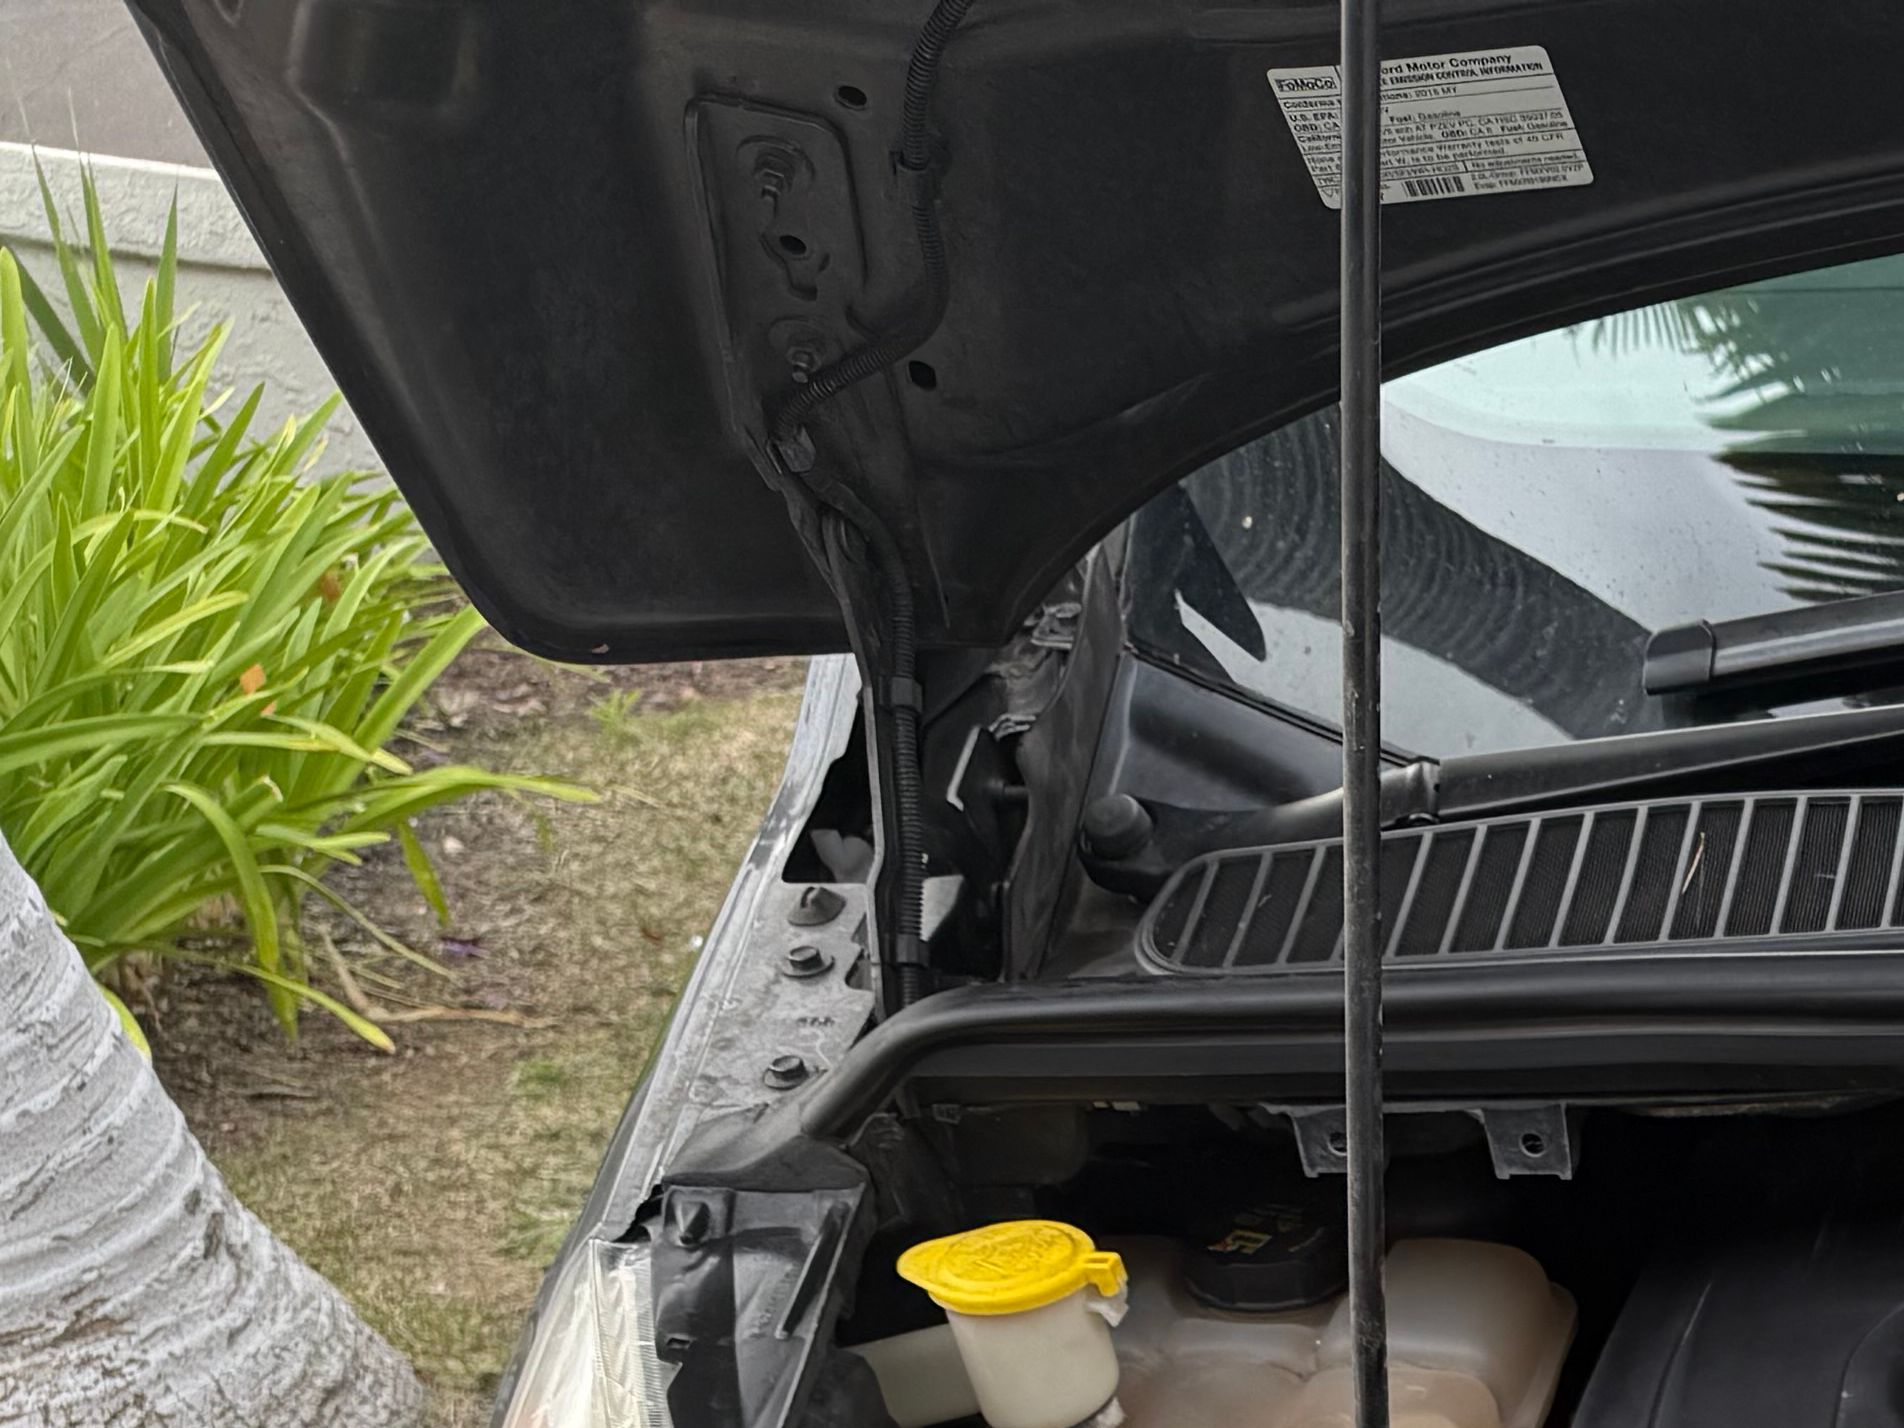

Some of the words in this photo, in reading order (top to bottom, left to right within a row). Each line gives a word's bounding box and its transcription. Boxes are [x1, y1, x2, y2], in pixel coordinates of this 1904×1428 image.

[1381, 64, 1403, 75] ord
[1406, 60, 1445, 73] Motor
[1449, 53, 1511, 68] Company
